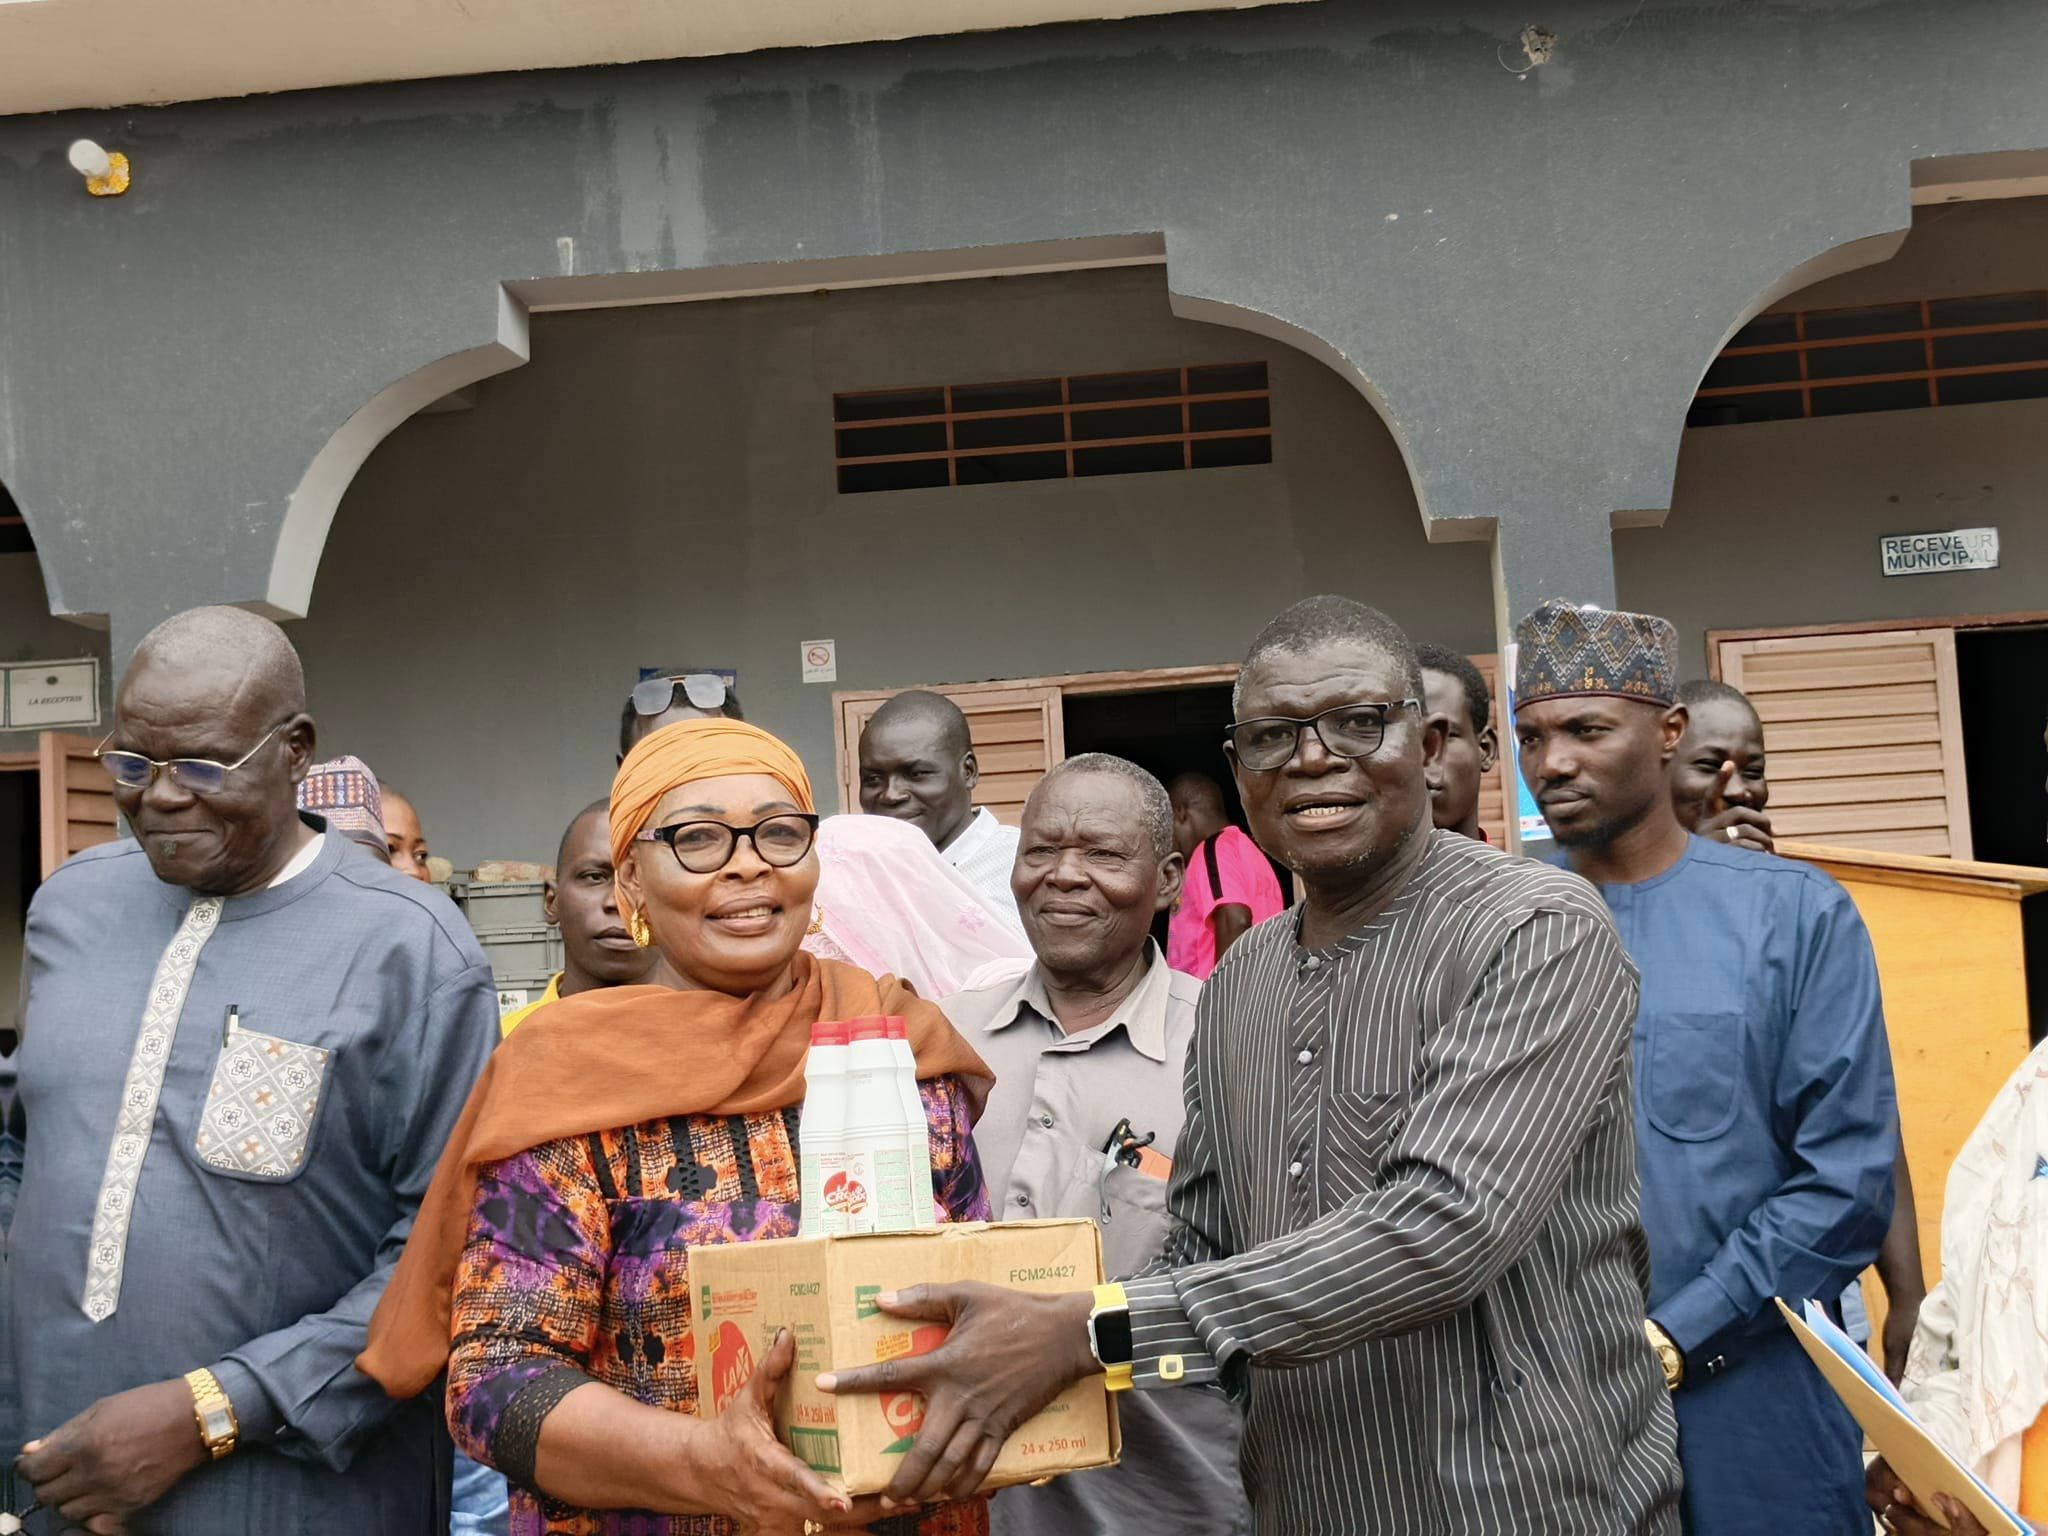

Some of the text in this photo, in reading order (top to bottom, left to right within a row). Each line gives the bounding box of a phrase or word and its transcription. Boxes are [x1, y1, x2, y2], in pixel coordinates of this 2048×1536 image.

[1886, 534, 1993, 554] RECEVEUR
[1009, 1265, 1077, 1283] FCM24427
[1021, 1436, 1087, 1455] 24 x 250 ml
